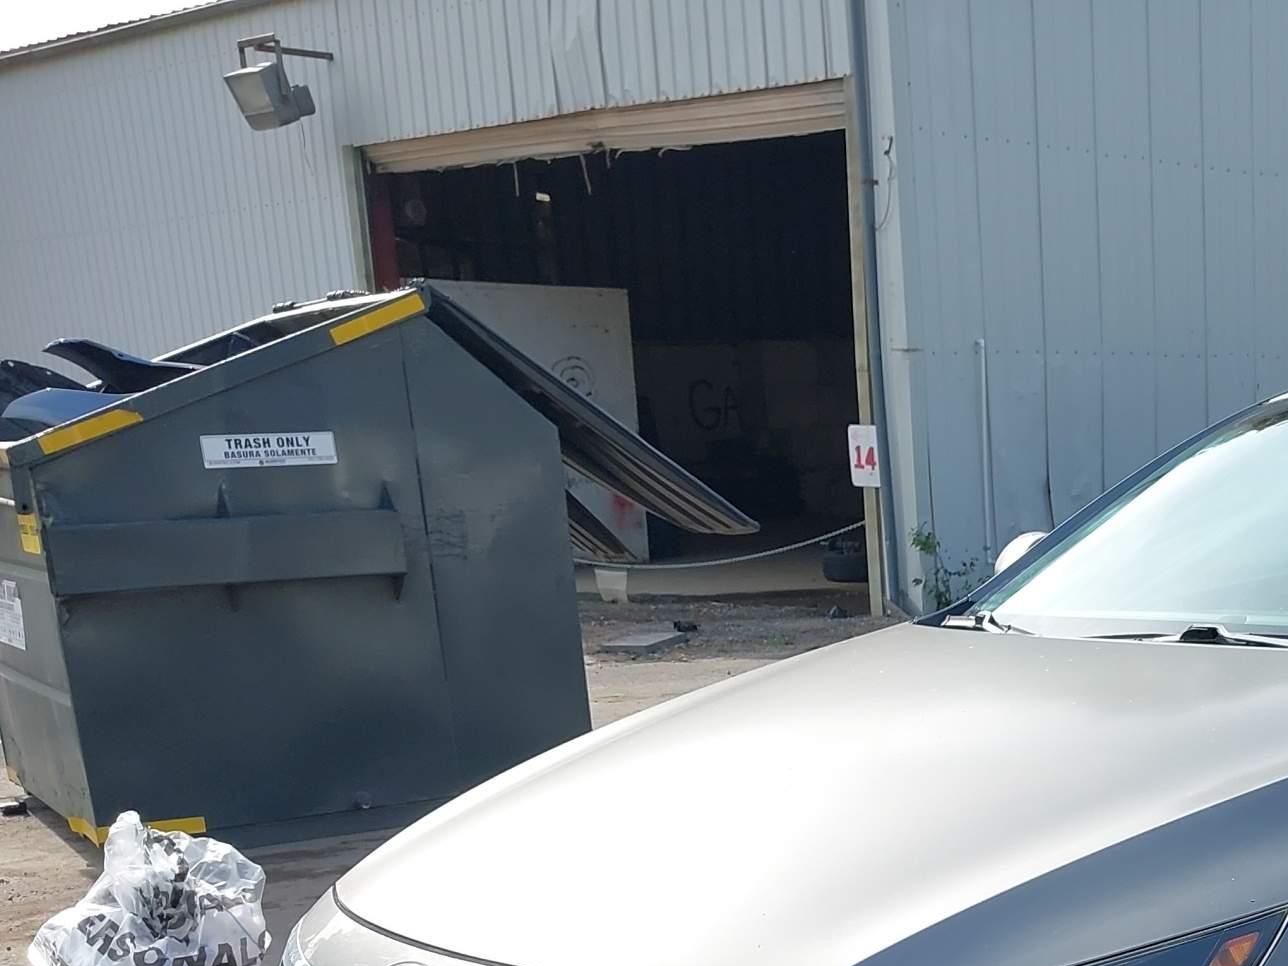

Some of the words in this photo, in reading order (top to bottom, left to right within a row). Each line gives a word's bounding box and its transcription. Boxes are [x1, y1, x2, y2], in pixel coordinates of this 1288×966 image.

[225, 437, 271, 450] TRASH
[276, 436, 310, 449] ONLY
[223, 450, 261, 459] BASURA
[264, 448, 316, 457] SOLAMENTE
[854, 445, 877, 470] 14
